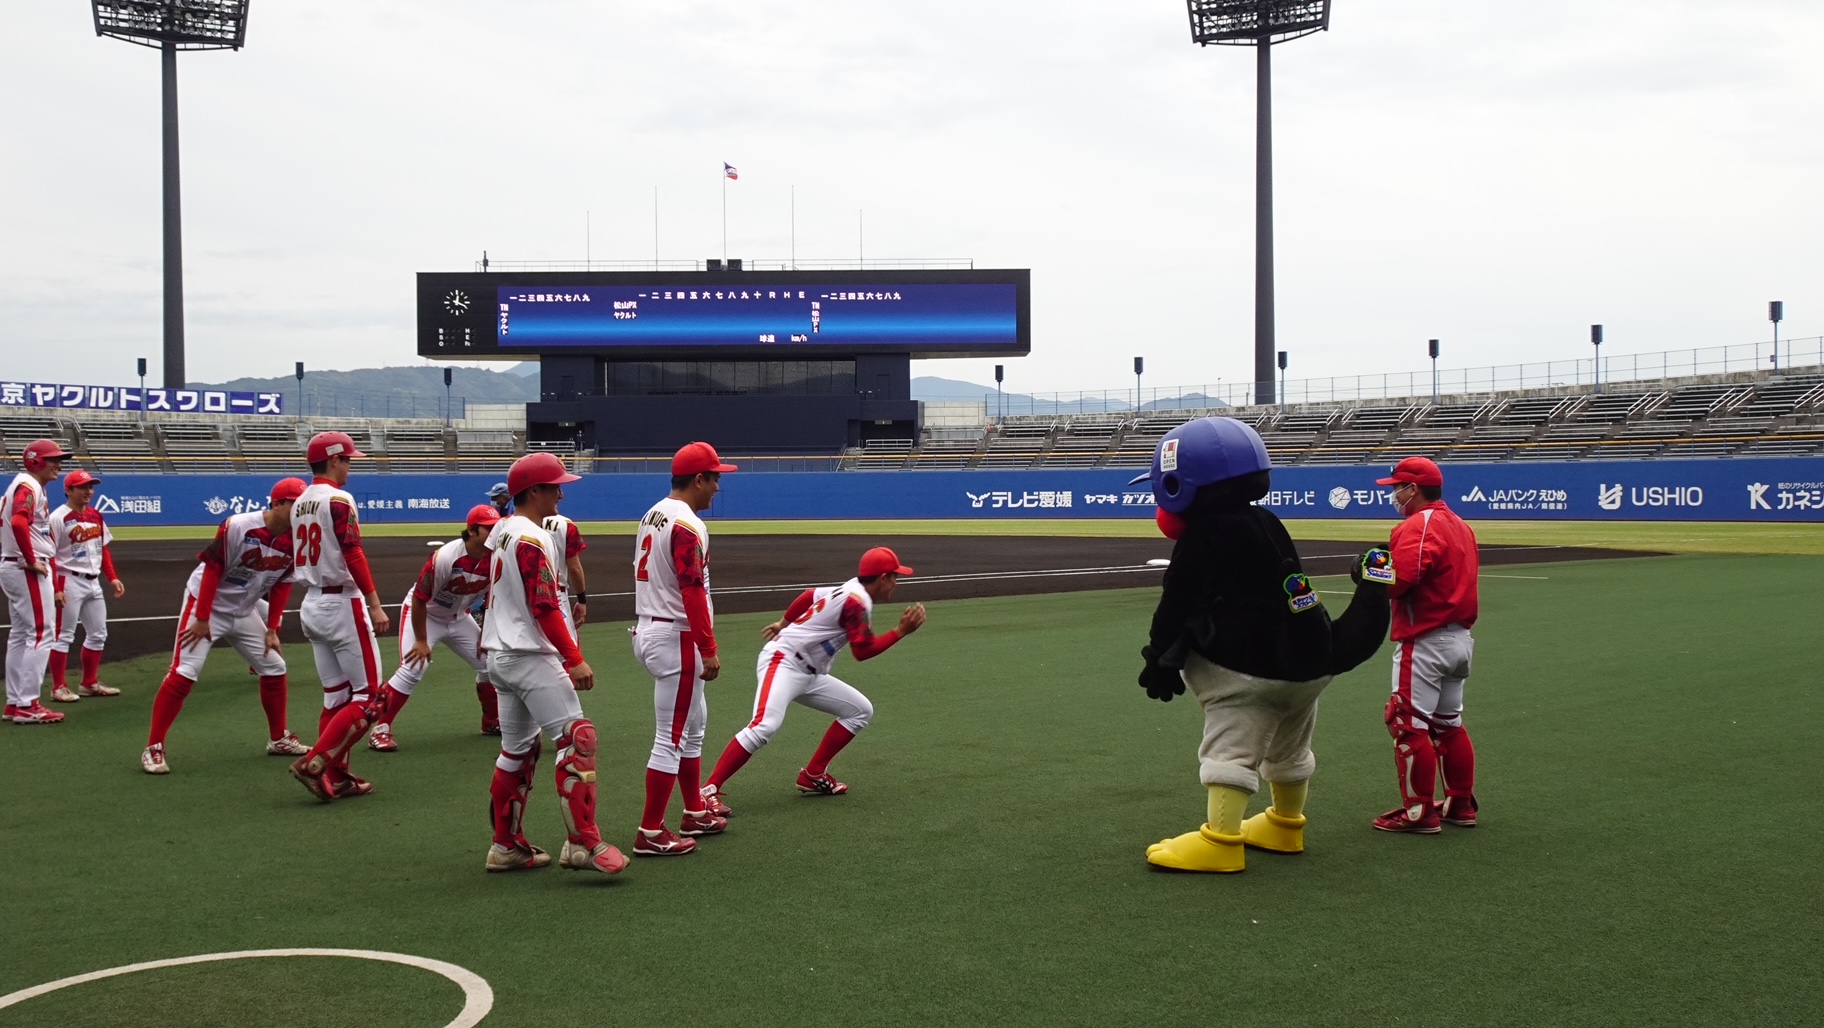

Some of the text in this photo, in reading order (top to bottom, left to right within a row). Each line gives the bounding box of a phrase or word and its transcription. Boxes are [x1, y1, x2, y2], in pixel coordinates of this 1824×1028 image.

[769, 291, 776, 299] R
[784, 291, 791, 299] H
[799, 291, 806, 299] E
[613, 311, 637, 320] ヤクルト
[500, 312, 509, 336] ヤクルト
[791, 334, 807, 342] km/h
[1, 382, 281, 413] 京ヤクルトスワローズ
[992, 491, 1073, 508] テレビ愛媛
[1084, 494, 1118, 504] ヤマキ
[1632, 487, 1704, 506] USHIO
[121, 500, 161, 513] 浅田組
[407, 499, 451, 509] 南海放送
[296, 522, 322, 567] 28
